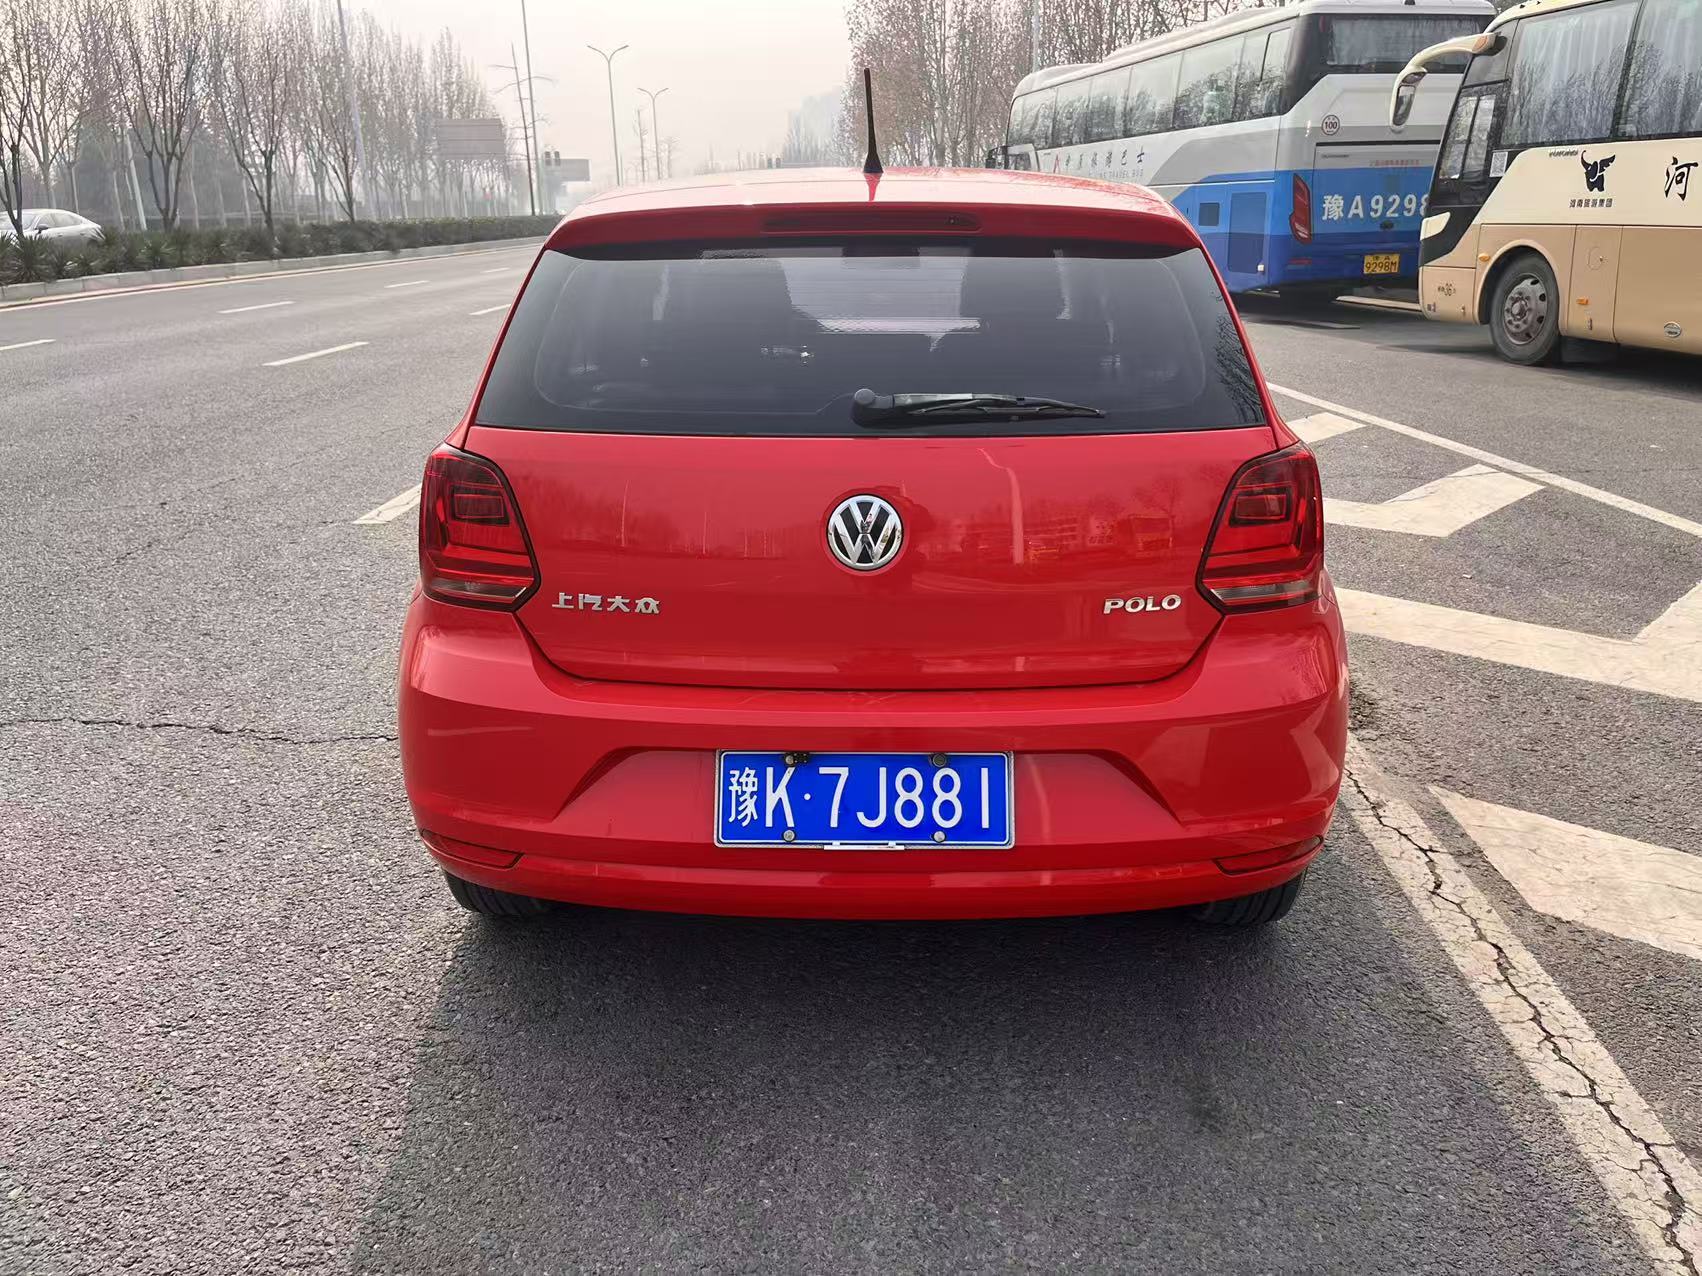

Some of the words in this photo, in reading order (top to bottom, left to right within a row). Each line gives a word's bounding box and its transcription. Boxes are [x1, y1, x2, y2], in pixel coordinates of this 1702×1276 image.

[1325, 121, 1338, 130] 100
[1664, 156, 1699, 202] 河
[1365, 261, 1398, 273] 9298M
[552, 592, 660, 614] 上汽大众
[1103, 594, 1182, 614] POLO
